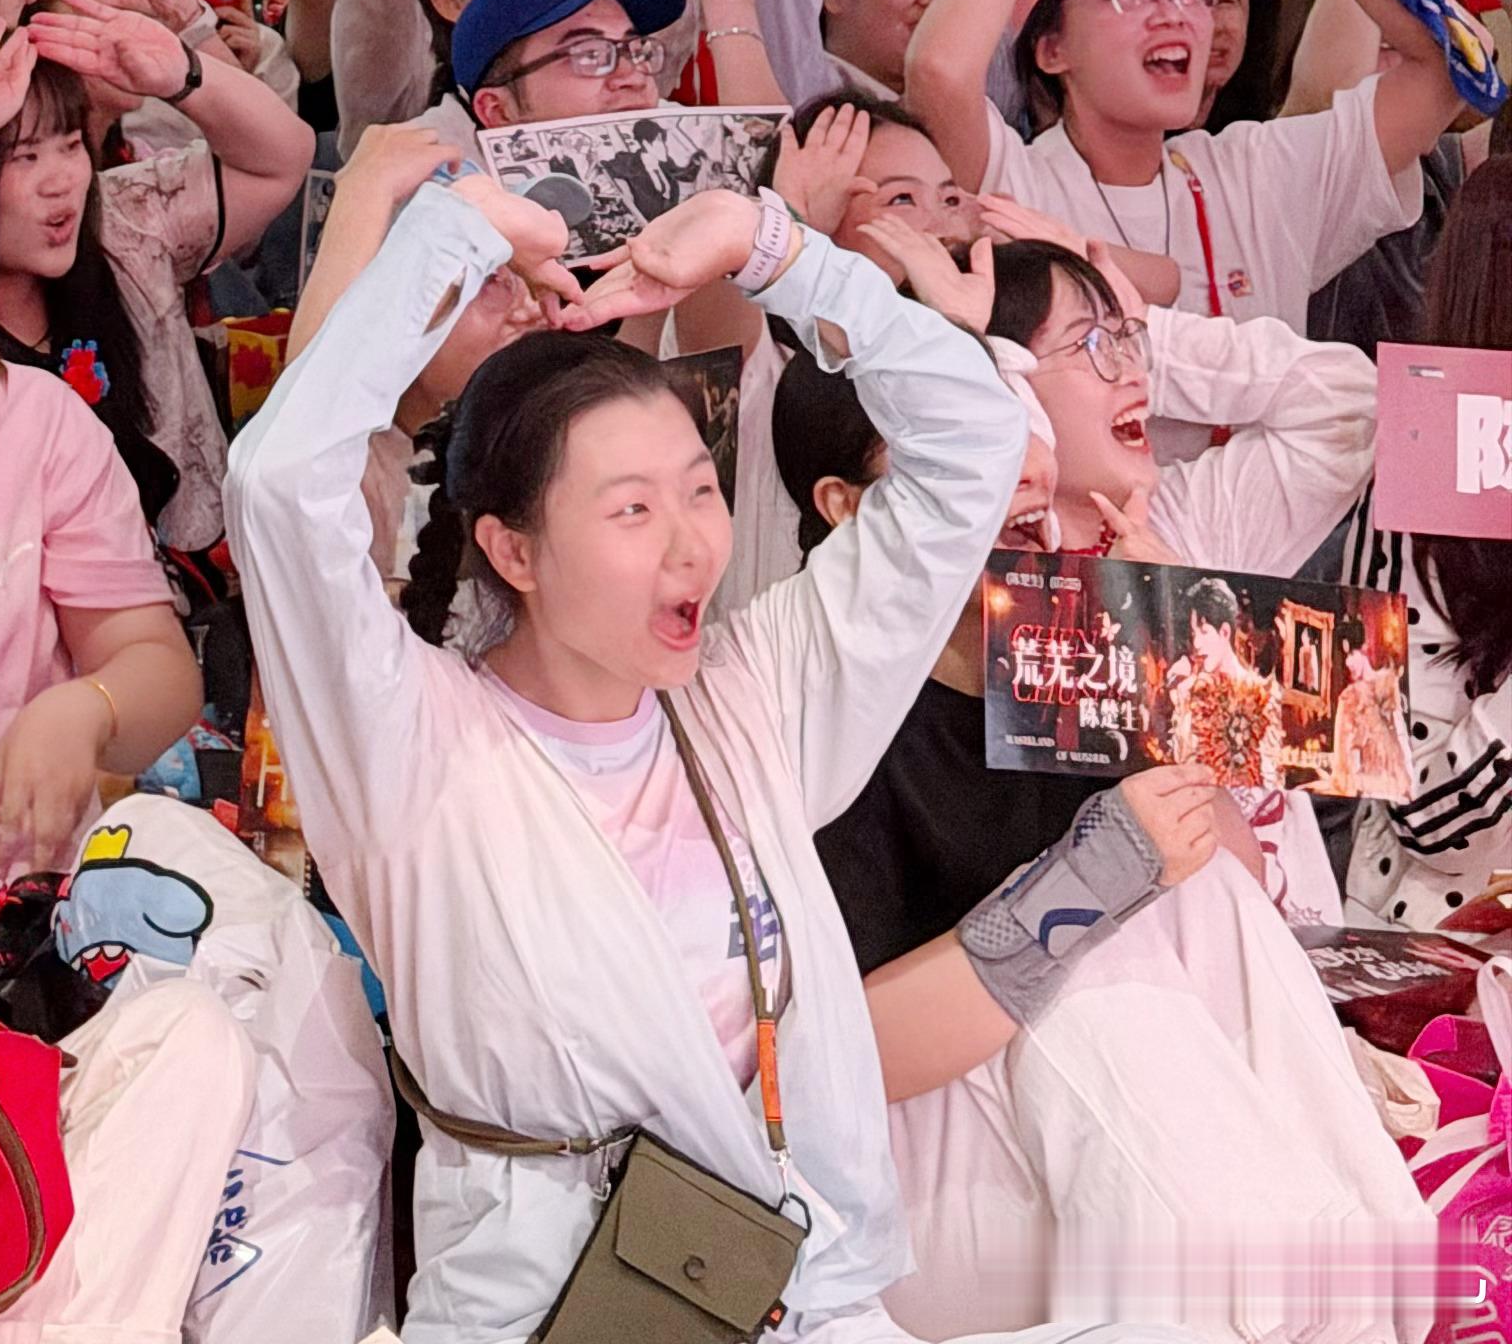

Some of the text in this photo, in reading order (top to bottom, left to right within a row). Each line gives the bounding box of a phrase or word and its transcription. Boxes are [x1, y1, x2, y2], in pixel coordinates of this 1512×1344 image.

[1012, 637, 1138, 694] 荒芜之境
[1080, 697, 1139, 731] 陈楚生
